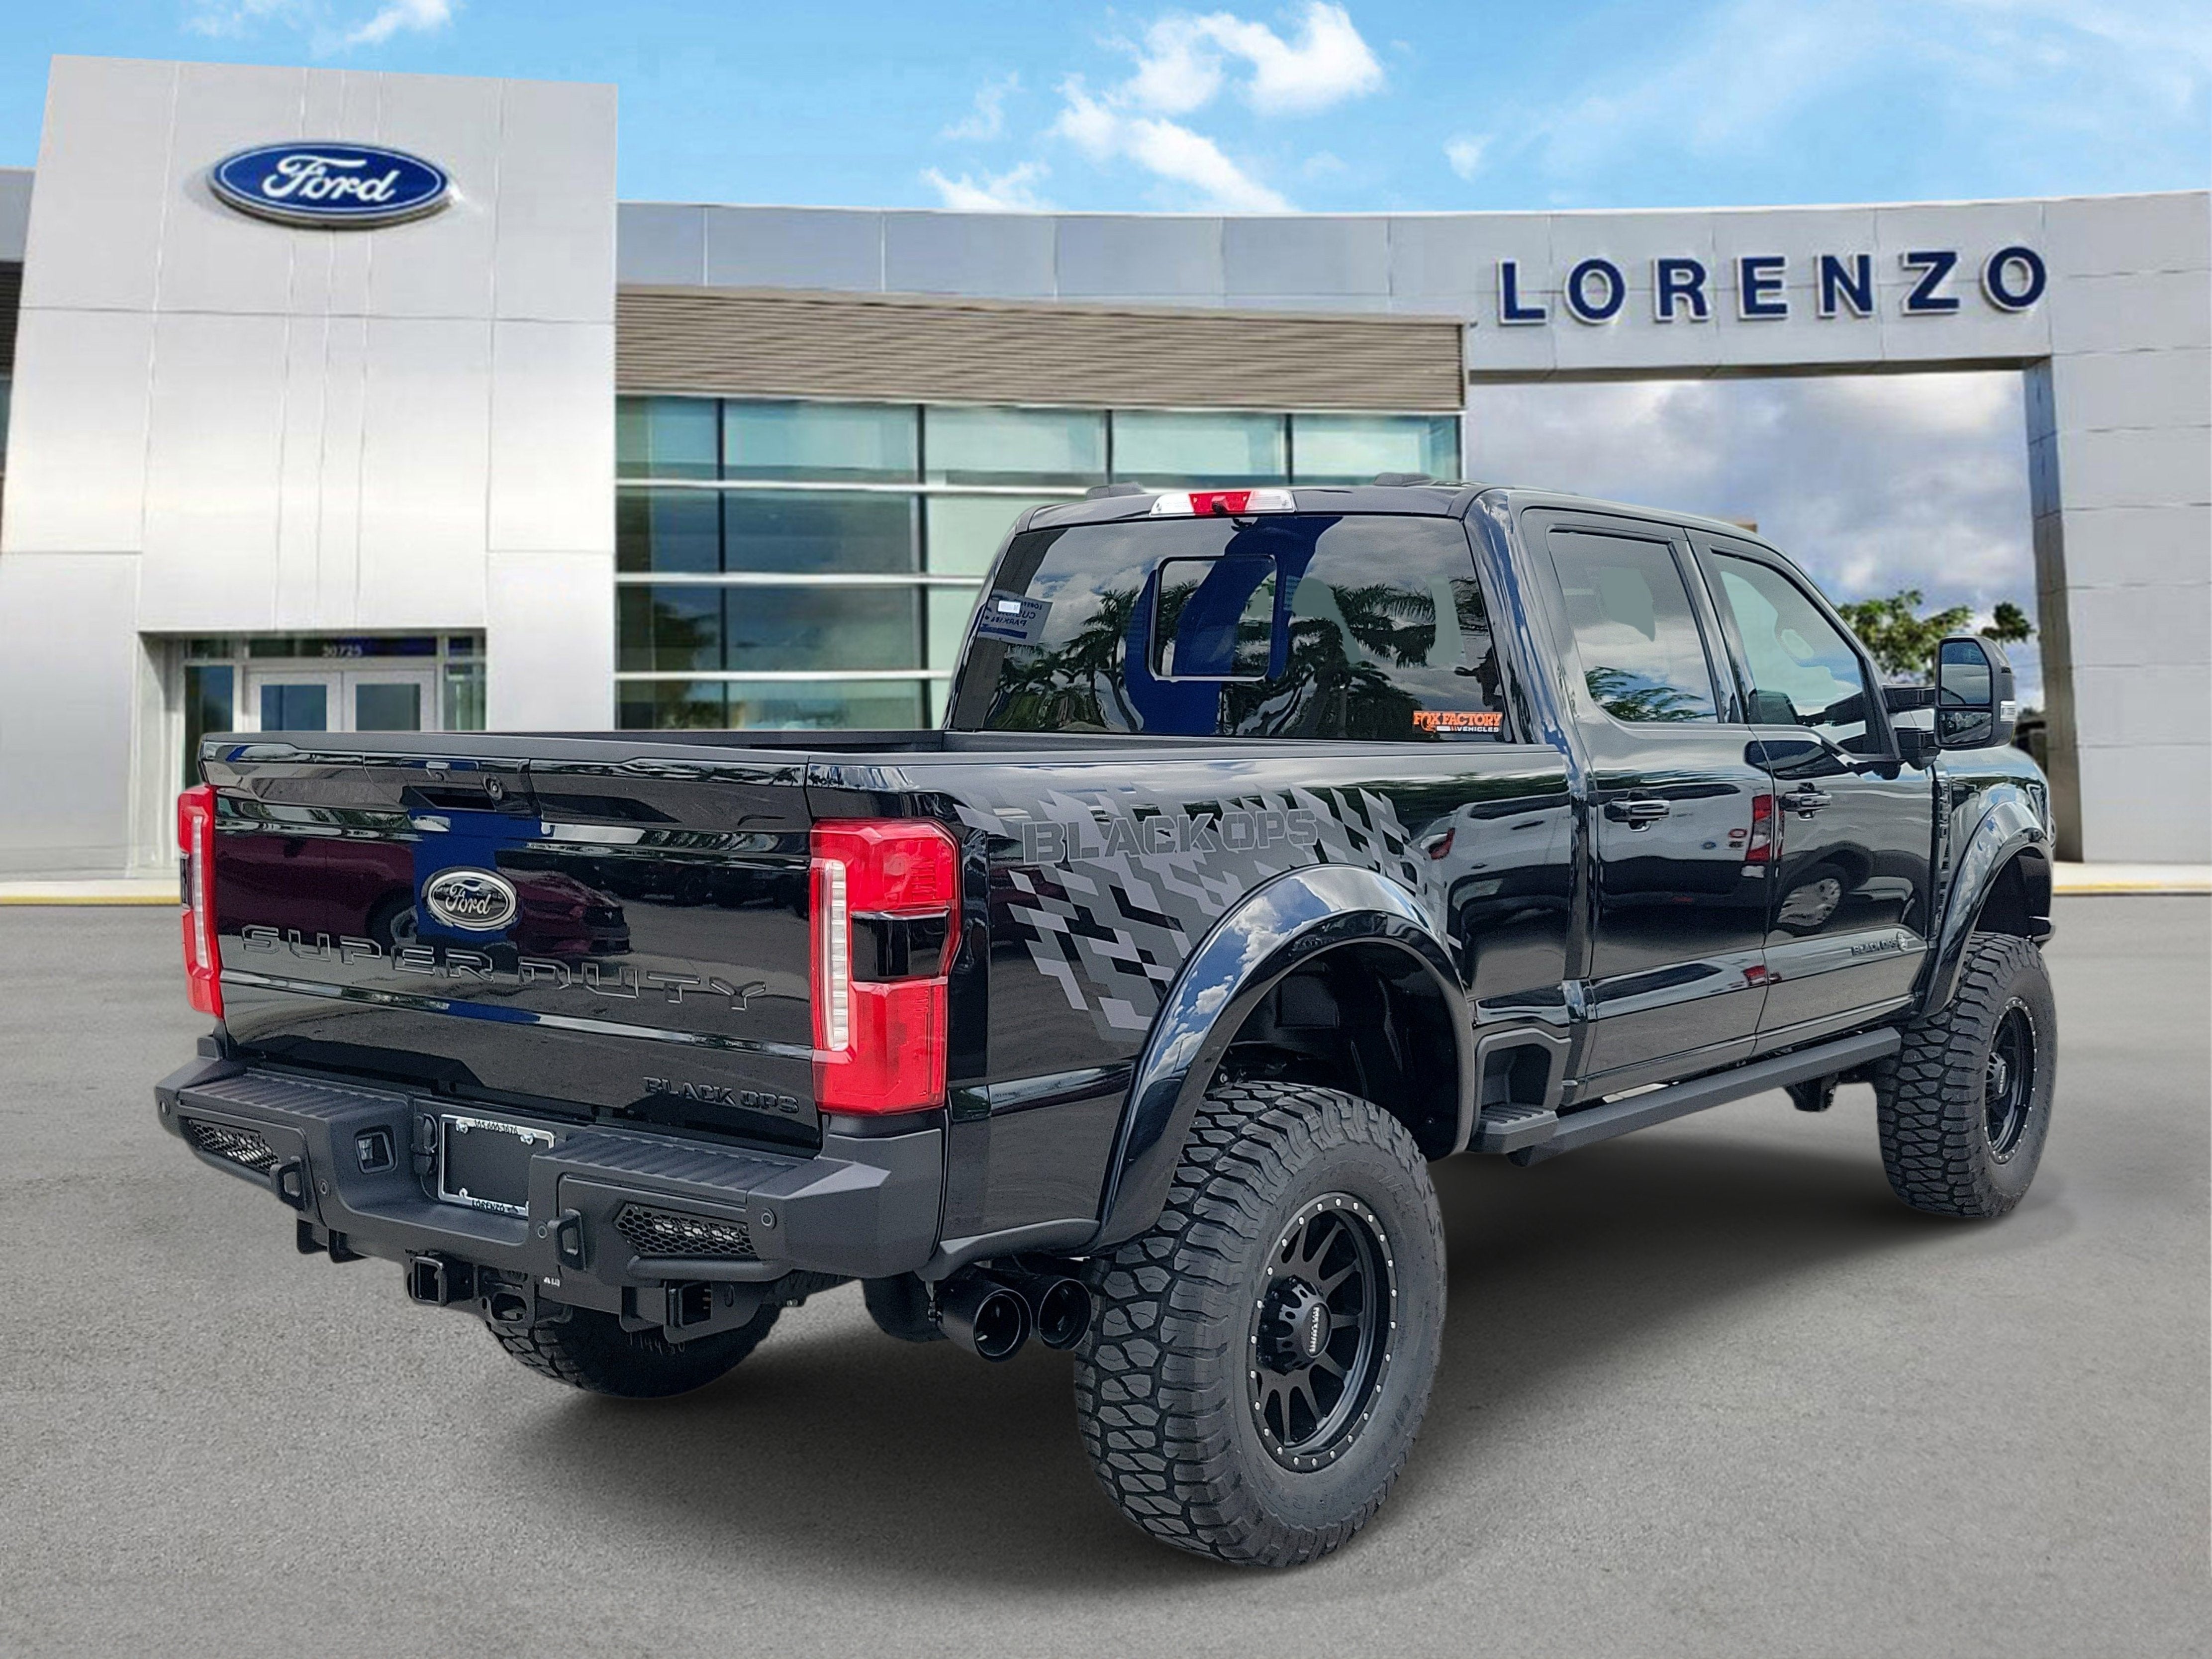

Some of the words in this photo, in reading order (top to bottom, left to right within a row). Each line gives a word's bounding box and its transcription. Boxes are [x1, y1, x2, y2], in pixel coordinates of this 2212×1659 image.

[262, 155, 400, 201] Ford
[1497, 246, 2048, 323] LORENZO
[1413, 712, 1441, 732] FOX
[1442, 712, 1503, 726] FACTORY
[1022, 813, 1217, 866] BLACK
[1220, 808, 1319, 850] OPS
[445, 883, 492, 914] Ford
[241, 924, 493, 983] SUPER
[517, 956, 767, 1011] DUTY
[643, 1076, 736, 1106] BLACK
[740, 1090, 800, 1113] OPS
[472, 1199, 505, 1213] LORENZO
